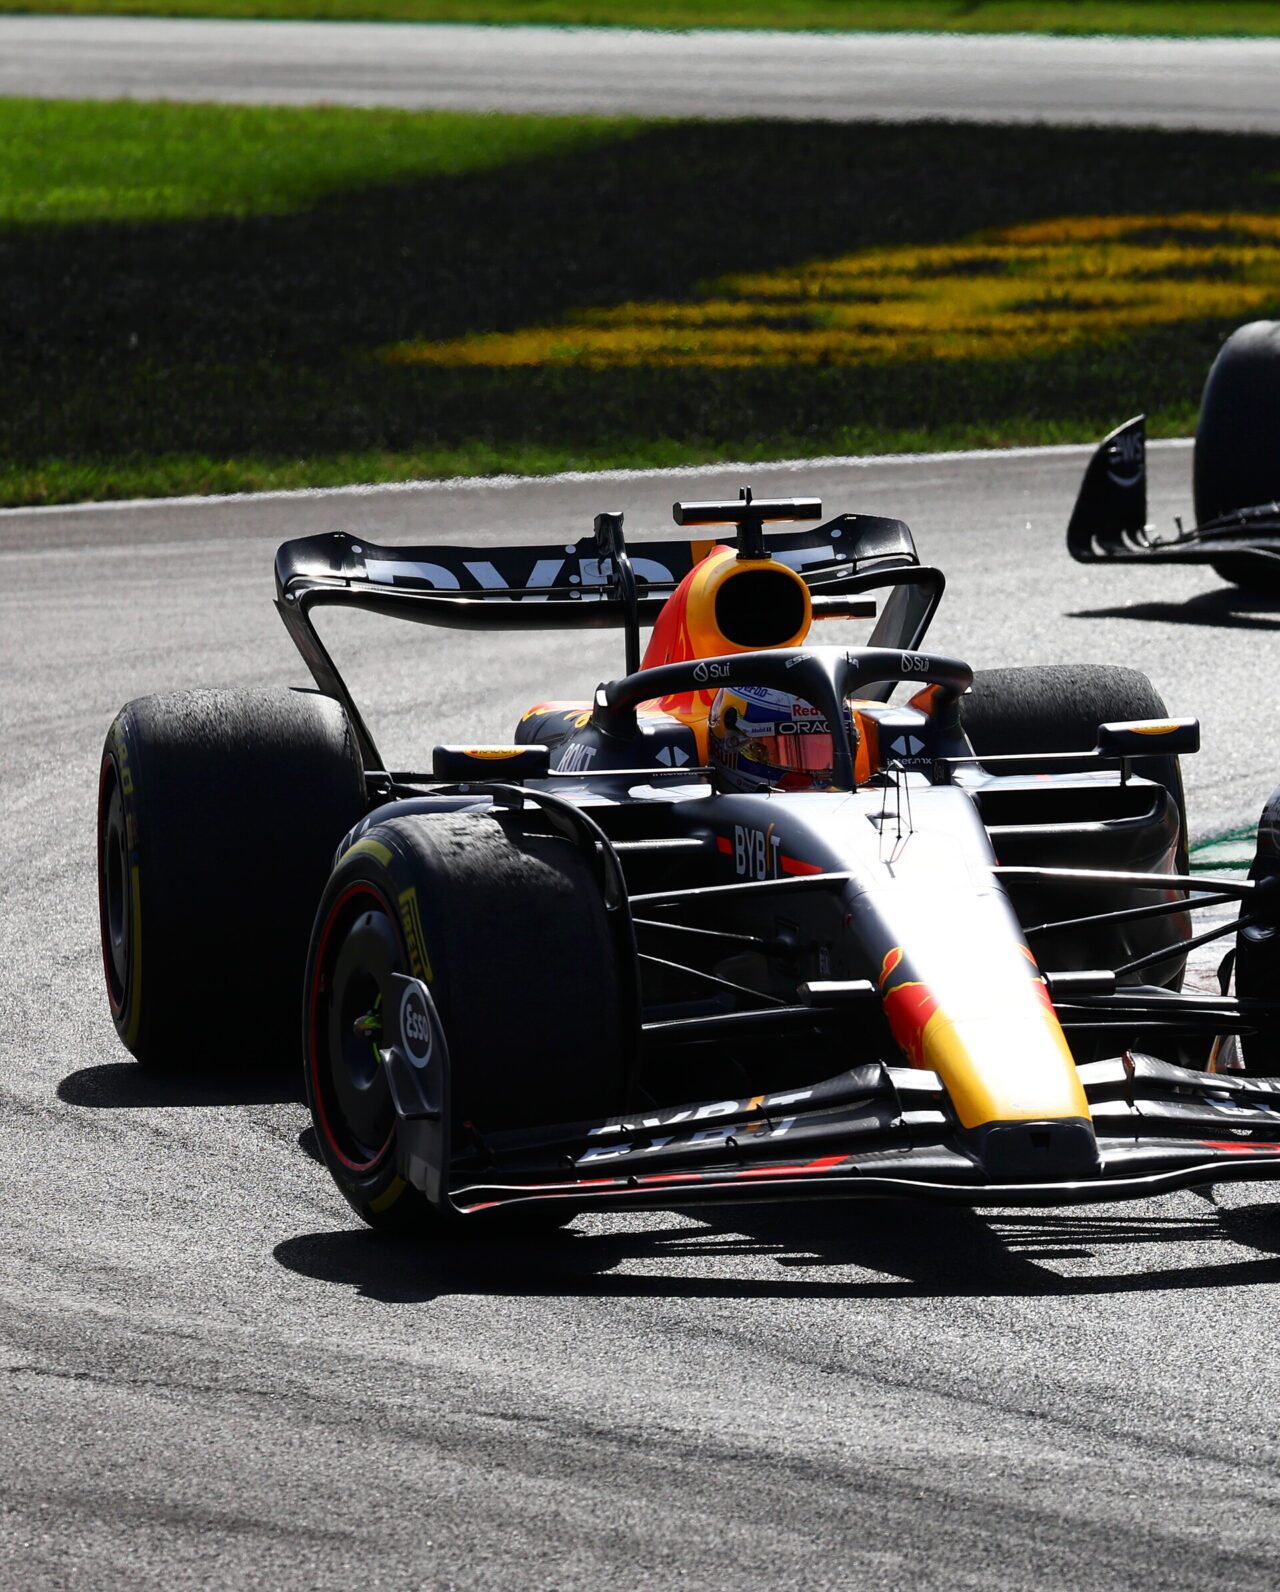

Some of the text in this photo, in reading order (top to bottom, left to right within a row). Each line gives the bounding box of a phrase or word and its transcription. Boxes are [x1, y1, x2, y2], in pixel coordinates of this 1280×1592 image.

[710, 663, 731, 679] Sui
[913, 657, 931, 673] Sui
[886, 757, 933, 767] iter.mx
[734, 823, 781, 881] BYBIT
[399, 885, 433, 984] PIRELL
[406, 1003, 428, 1043] Esso
